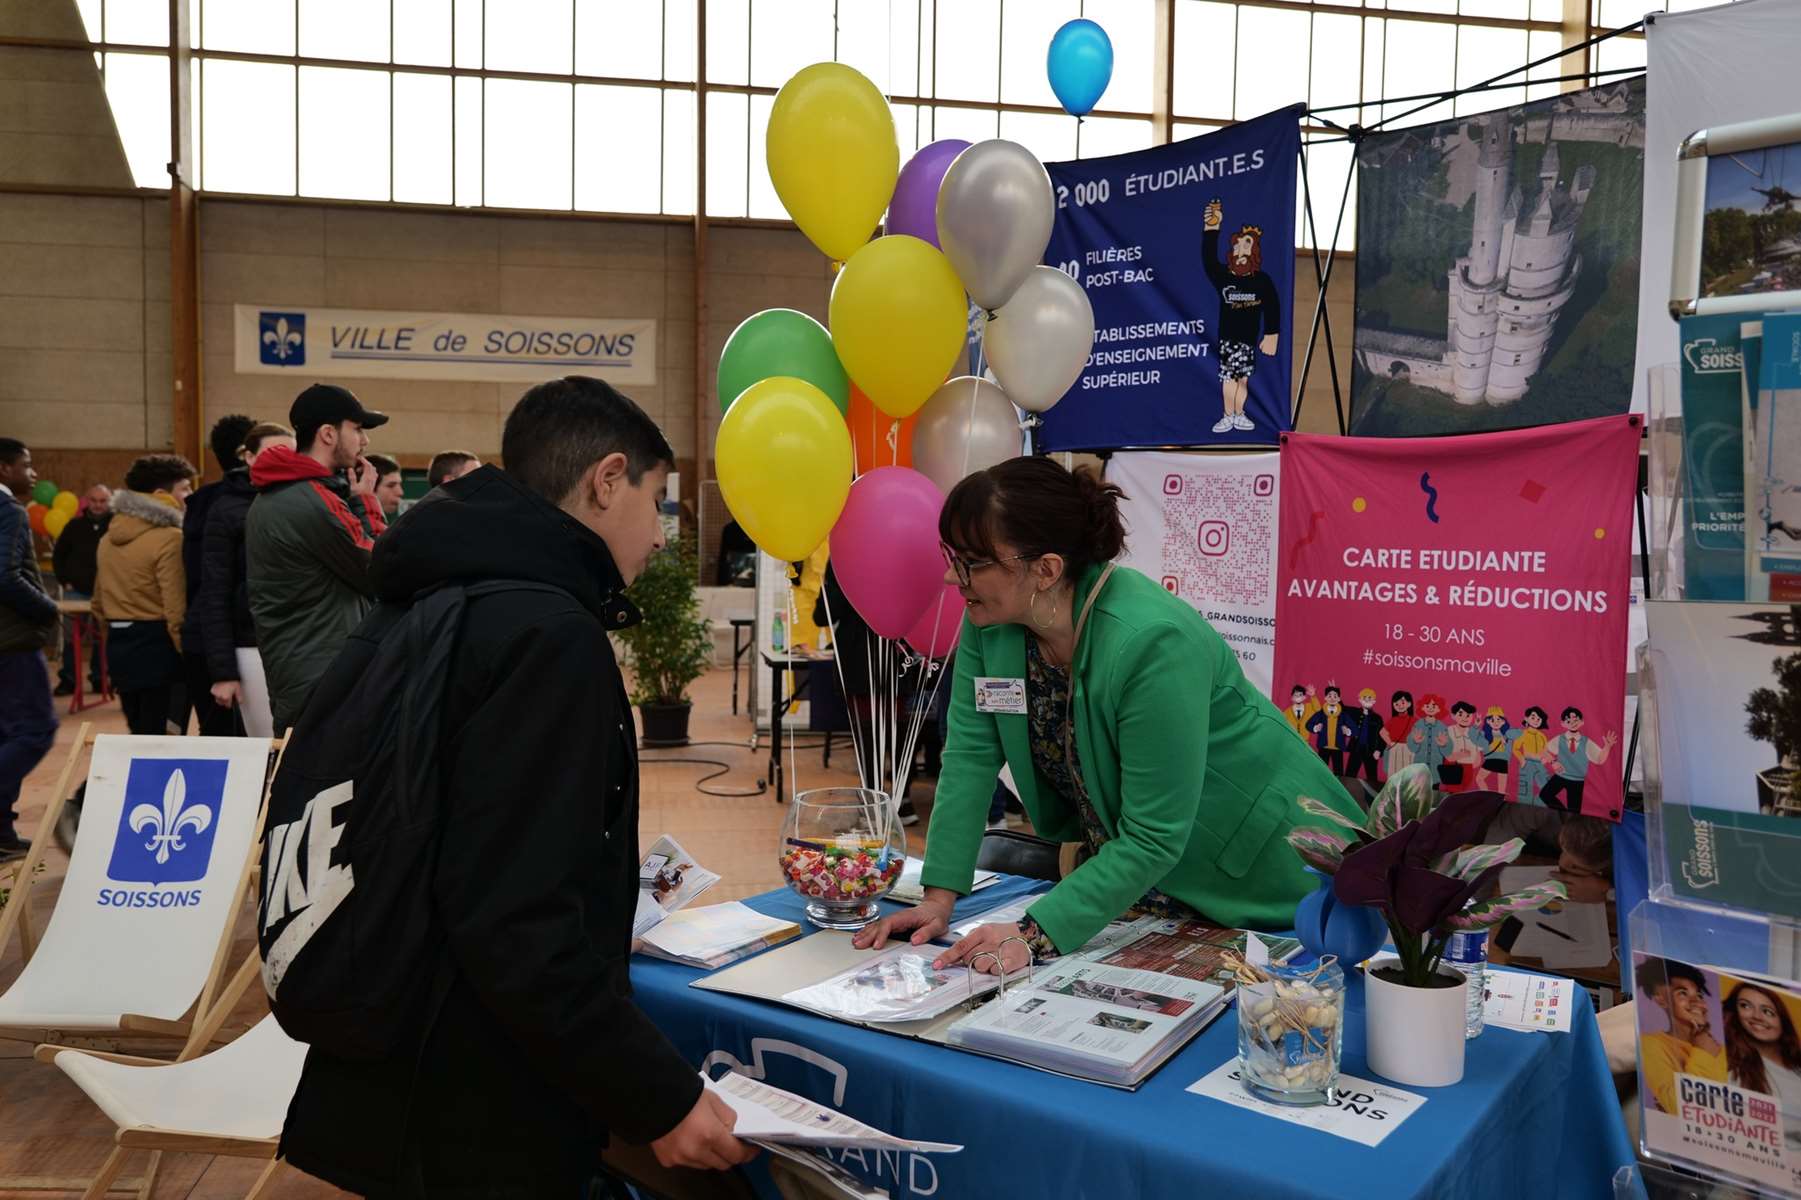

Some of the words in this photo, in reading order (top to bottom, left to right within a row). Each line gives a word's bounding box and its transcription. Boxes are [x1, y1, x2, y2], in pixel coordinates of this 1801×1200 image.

[1075, 179, 1110, 207] 000
[1125, 149, 1264, 196] ÉTUDIANT.E.S
[1086, 246, 1143, 265] FILIÈRES
[1086, 268, 1154, 288] POST-BAC
[330, 326, 415, 351] VILLE
[433, 329, 468, 353] de
[483, 330, 635, 357] SOISSONS
[1093, 319, 1205, 343] TABLISSEMENTS
[1084, 343, 1209, 367] D'ENSEIGNEMENT
[1082, 370, 1161, 390] SUPÉRIEUR
[1343, 547, 1412, 569] CARTE
[1419, 550, 1547, 573] ETUDIANTE
[1287, 578, 1417, 604] AVANTAGES
[1424, 585, 1441, 605] &
[1449, 579, 1608, 613] RÉDUCTIONS
[1384, 623, 1403, 641] 18
[1419, 626, 1442, 644] 30
[1446, 628, 1486, 646] ANS
[1362, 650, 1512, 677] #soissonsmaville
[97, 889, 202, 908] SOISSONS
[1681, 1078, 1744, 1118] carte
[1747, 1141, 1781, 1158] ANS
